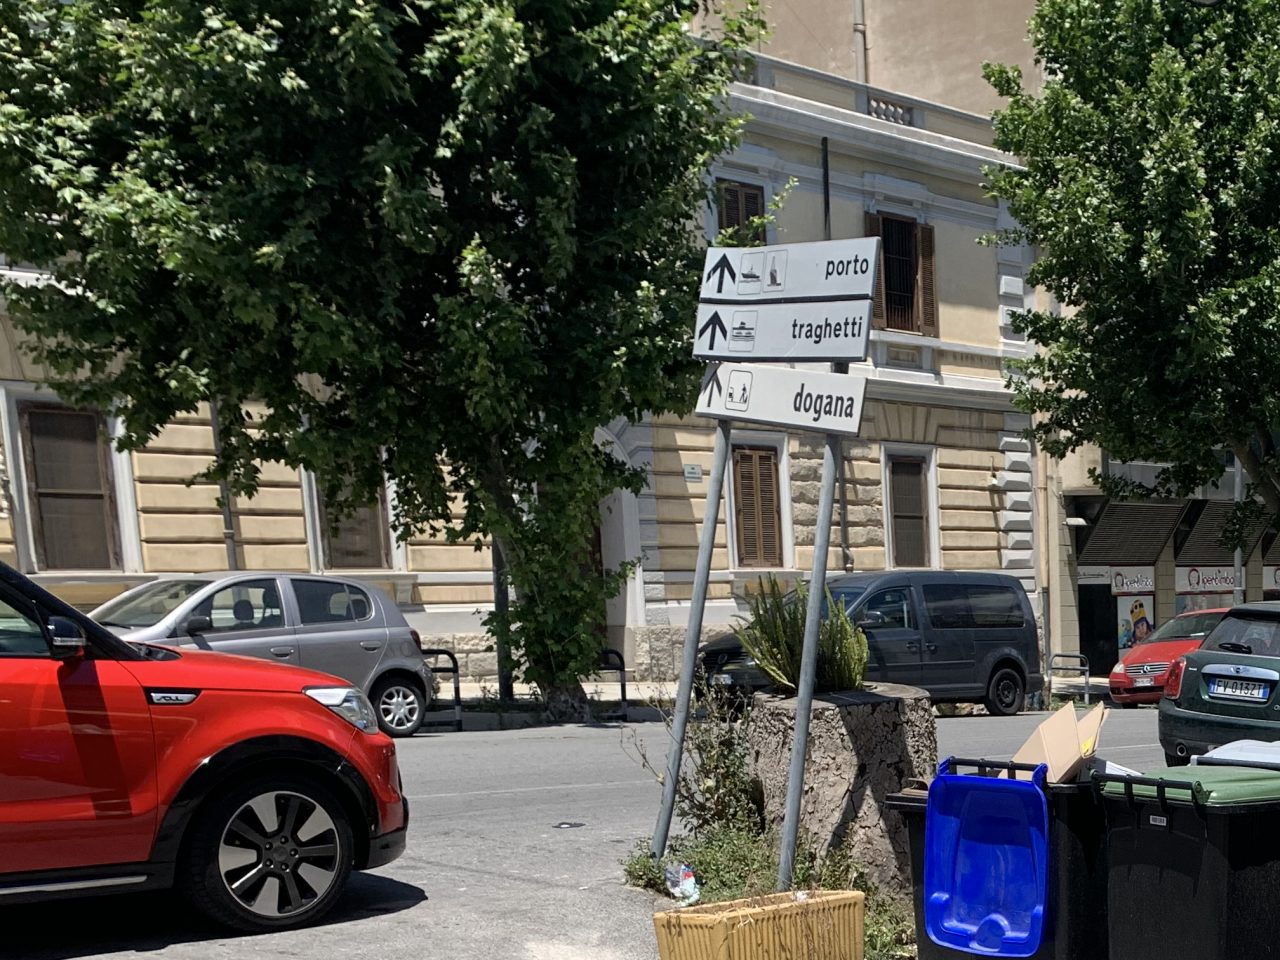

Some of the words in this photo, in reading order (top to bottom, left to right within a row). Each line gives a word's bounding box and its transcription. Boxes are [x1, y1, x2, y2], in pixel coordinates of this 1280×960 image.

[825, 254, 869, 280] porto
[791, 316, 863, 345] traghetti
[793, 383, 855, 422] dogana
